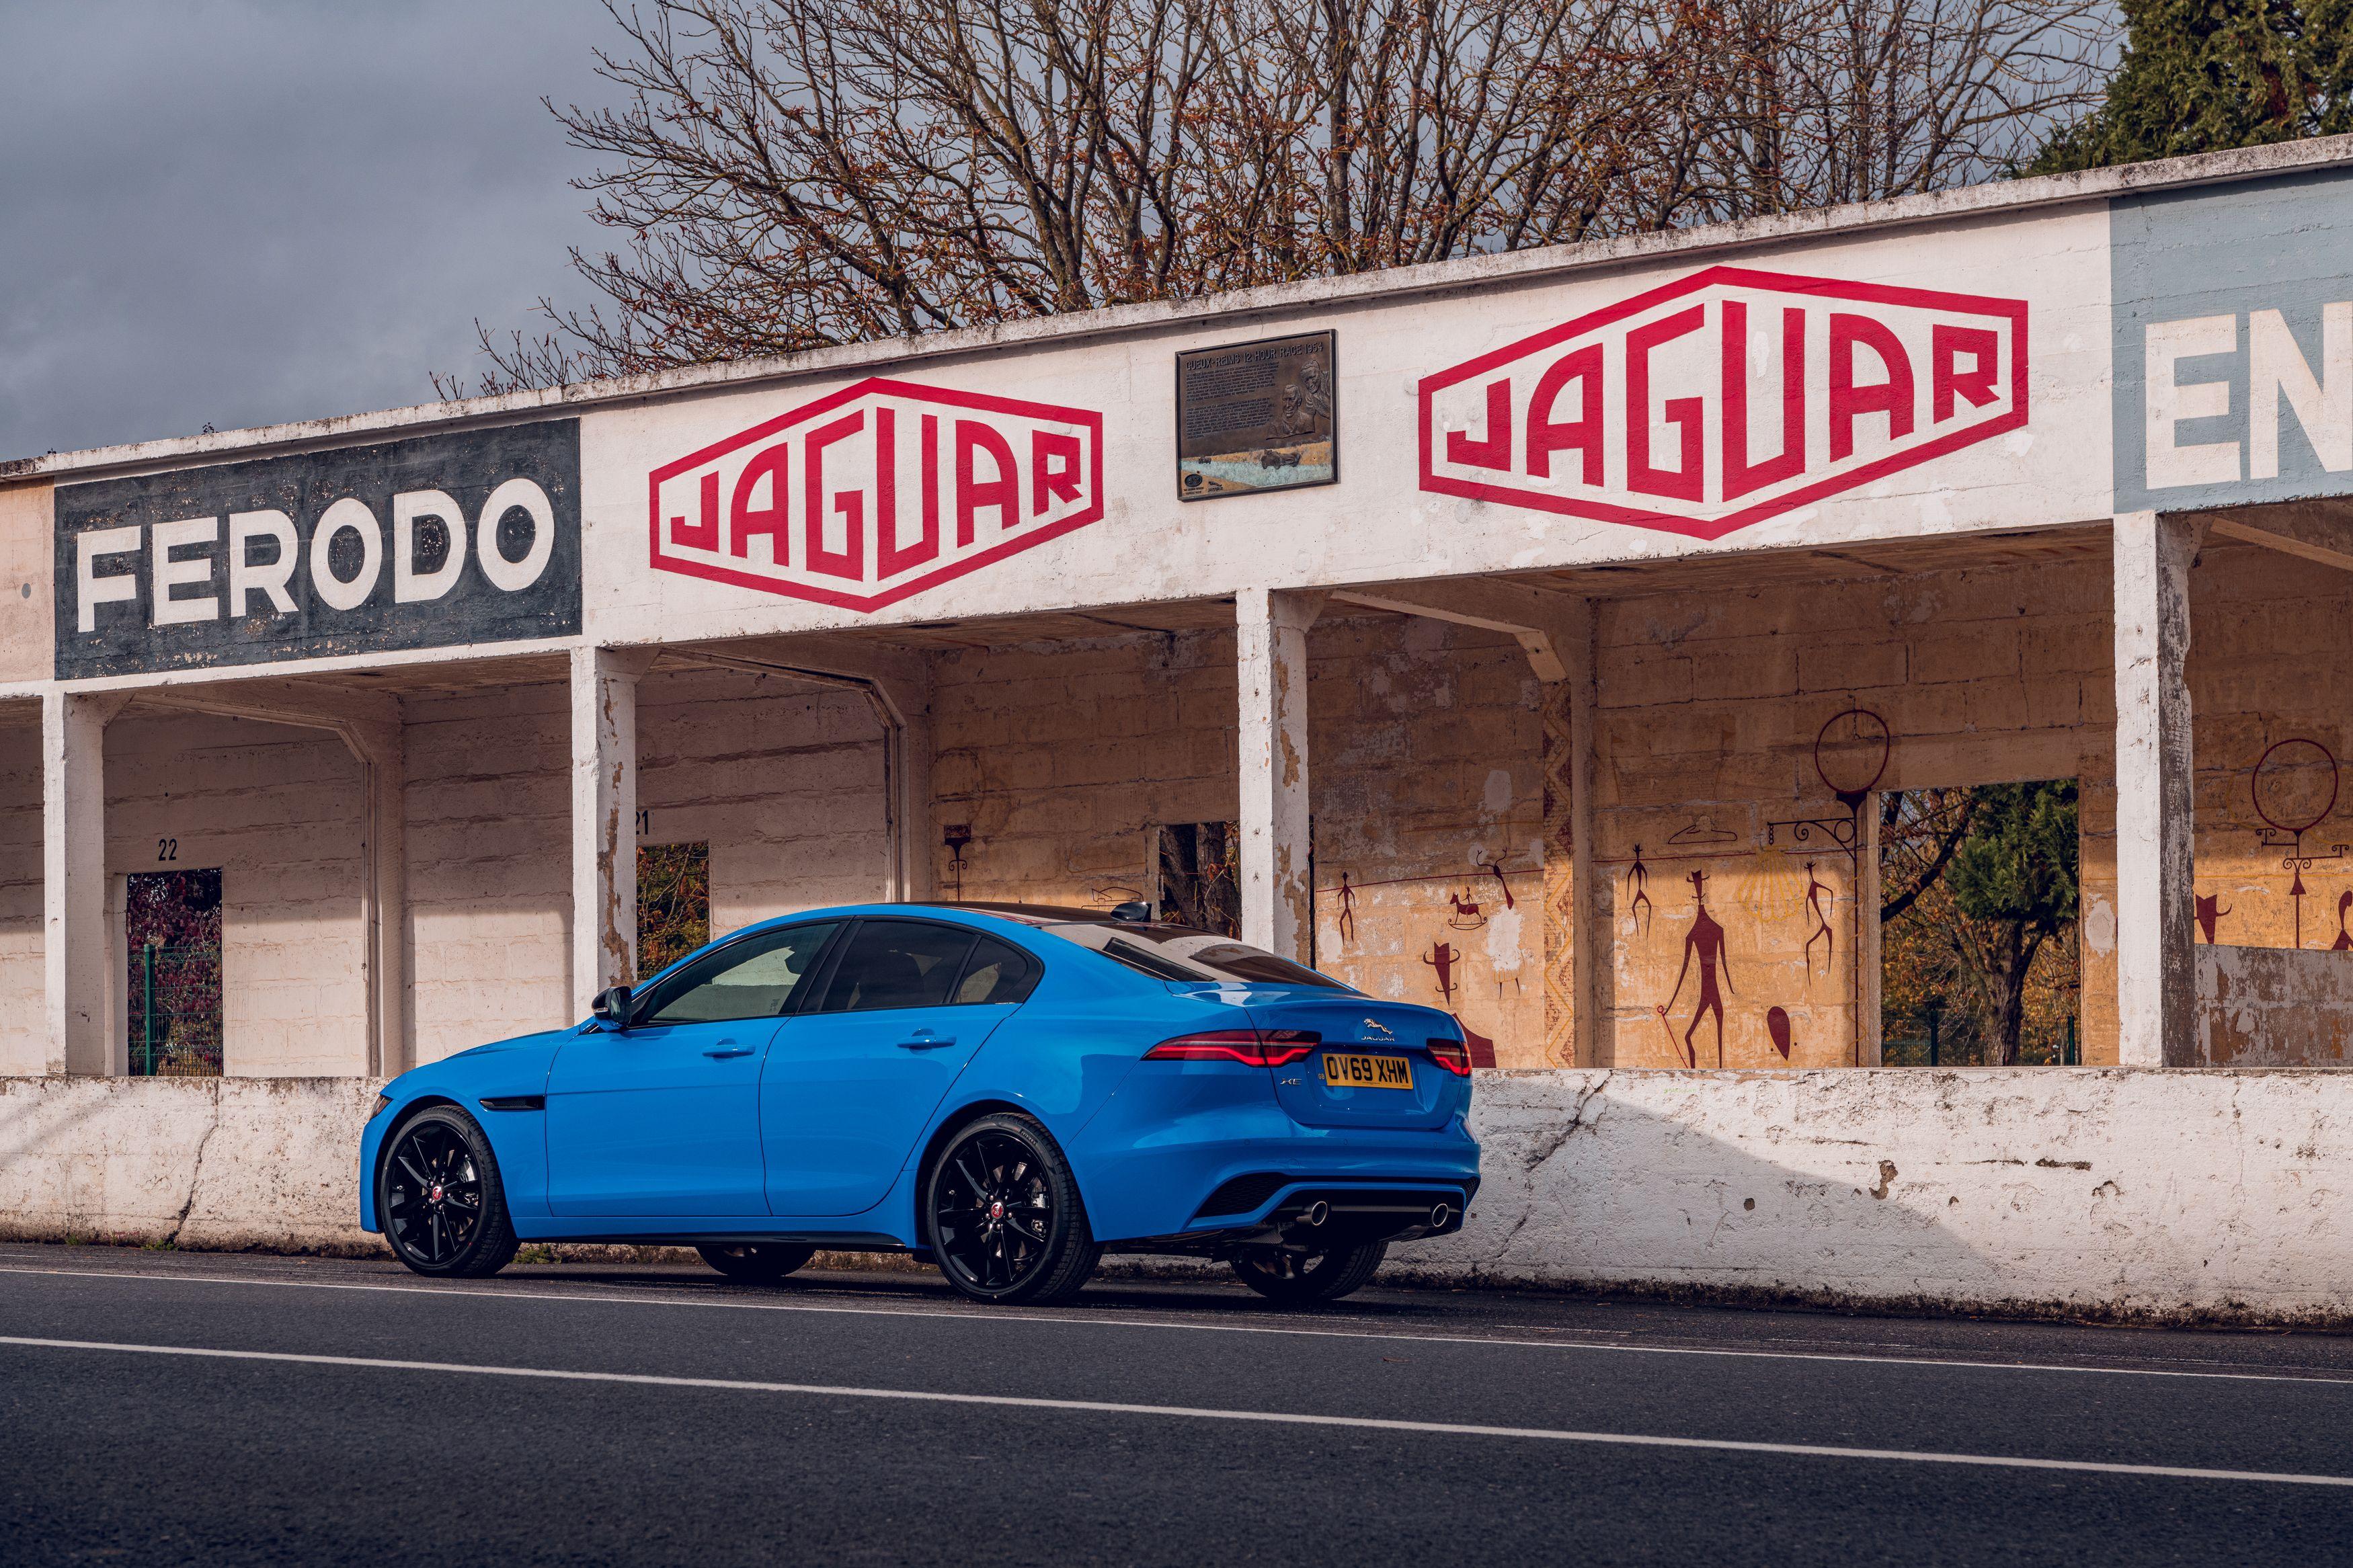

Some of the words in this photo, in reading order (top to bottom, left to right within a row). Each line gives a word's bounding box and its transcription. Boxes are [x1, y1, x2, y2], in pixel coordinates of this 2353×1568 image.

[1186, 354, 1240, 370] GUEUX-REIMS
[1244, 352, 1252, 362] 12
[1254, 348, 1277, 361] HOUR
[1279, 345, 1302, 358] RACE
[1305, 341, 1324, 354] 1954
[1447, 300, 2001, 503] JAGUAR
[2145, 300, 2353, 490] EN
[77, 478, 555, 633] FERODO
[671, 407, 1083, 583] JAGUAR
[158, 838, 177, 862] 22
[1326, 1056, 1373, 1081] OV69
[1375, 1059, 1409, 1084] XHM
